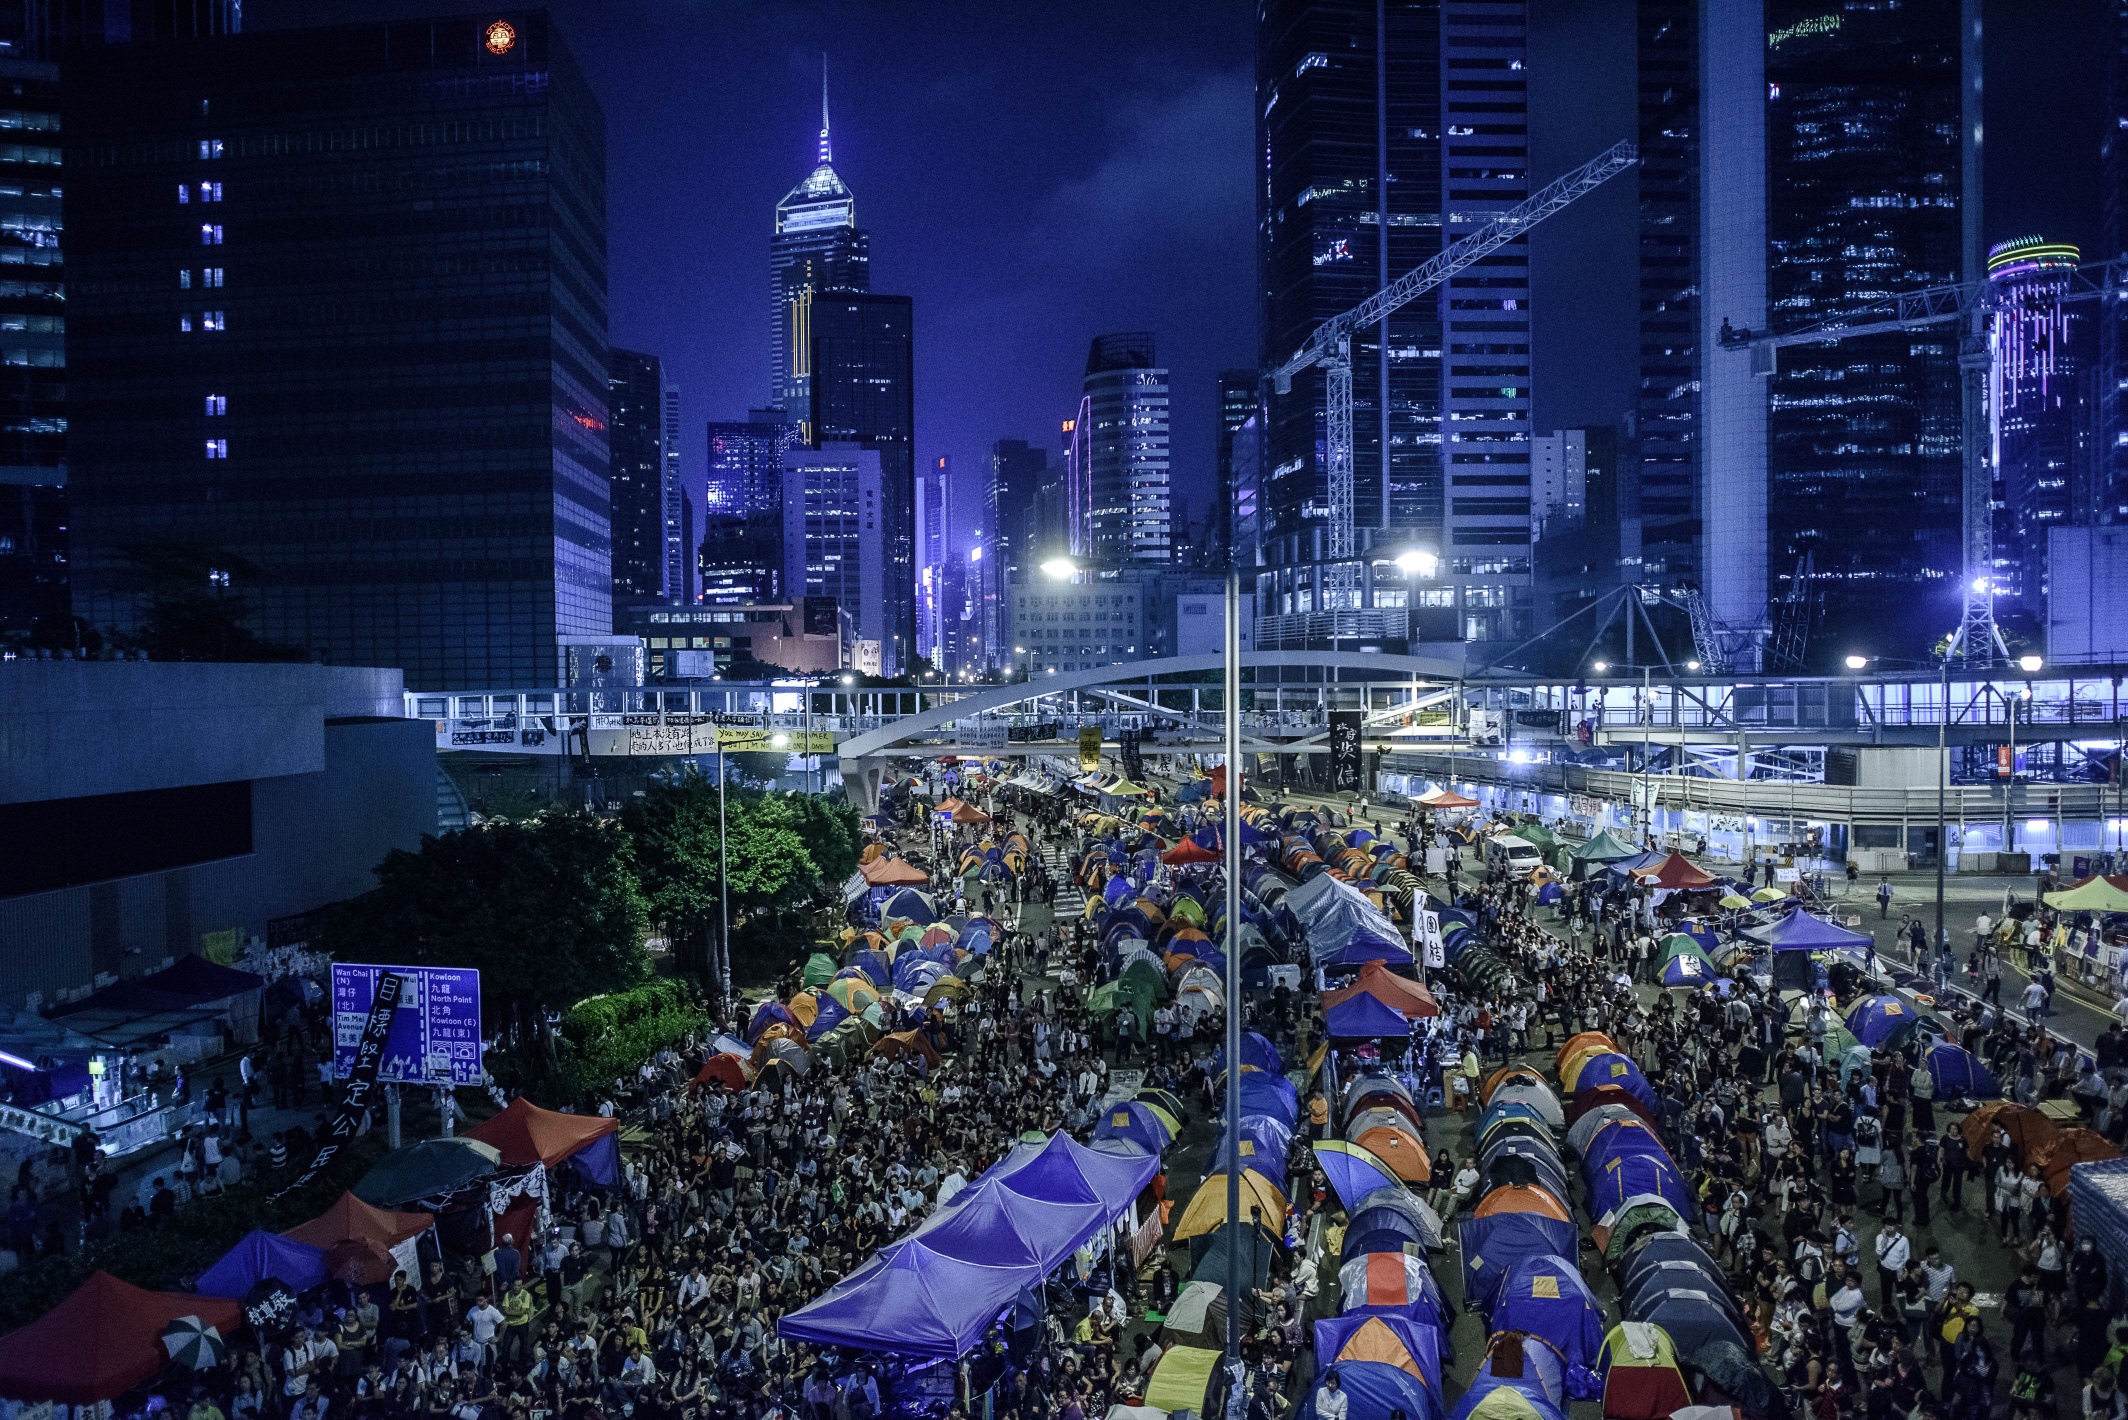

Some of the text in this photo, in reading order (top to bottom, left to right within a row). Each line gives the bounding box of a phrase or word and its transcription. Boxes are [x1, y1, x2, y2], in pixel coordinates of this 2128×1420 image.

[336, 969, 368, 978] Wan Chai
[429, 972, 461, 981] Kowloon
[336, 977, 350, 986] (N)
[337, 988, 357, 998] 灣仔
[431, 984, 451, 994] 九龍
[431, 995, 472, 1004] North Point
[431, 1006, 451, 1016] 北角
[337, 1015, 365, 1023] Tim Mei
[431, 1017, 477, 1027] Kowloon (E)
[337, 1022, 364, 1031] Avenue
[338, 1032, 363, 1043] 添美
